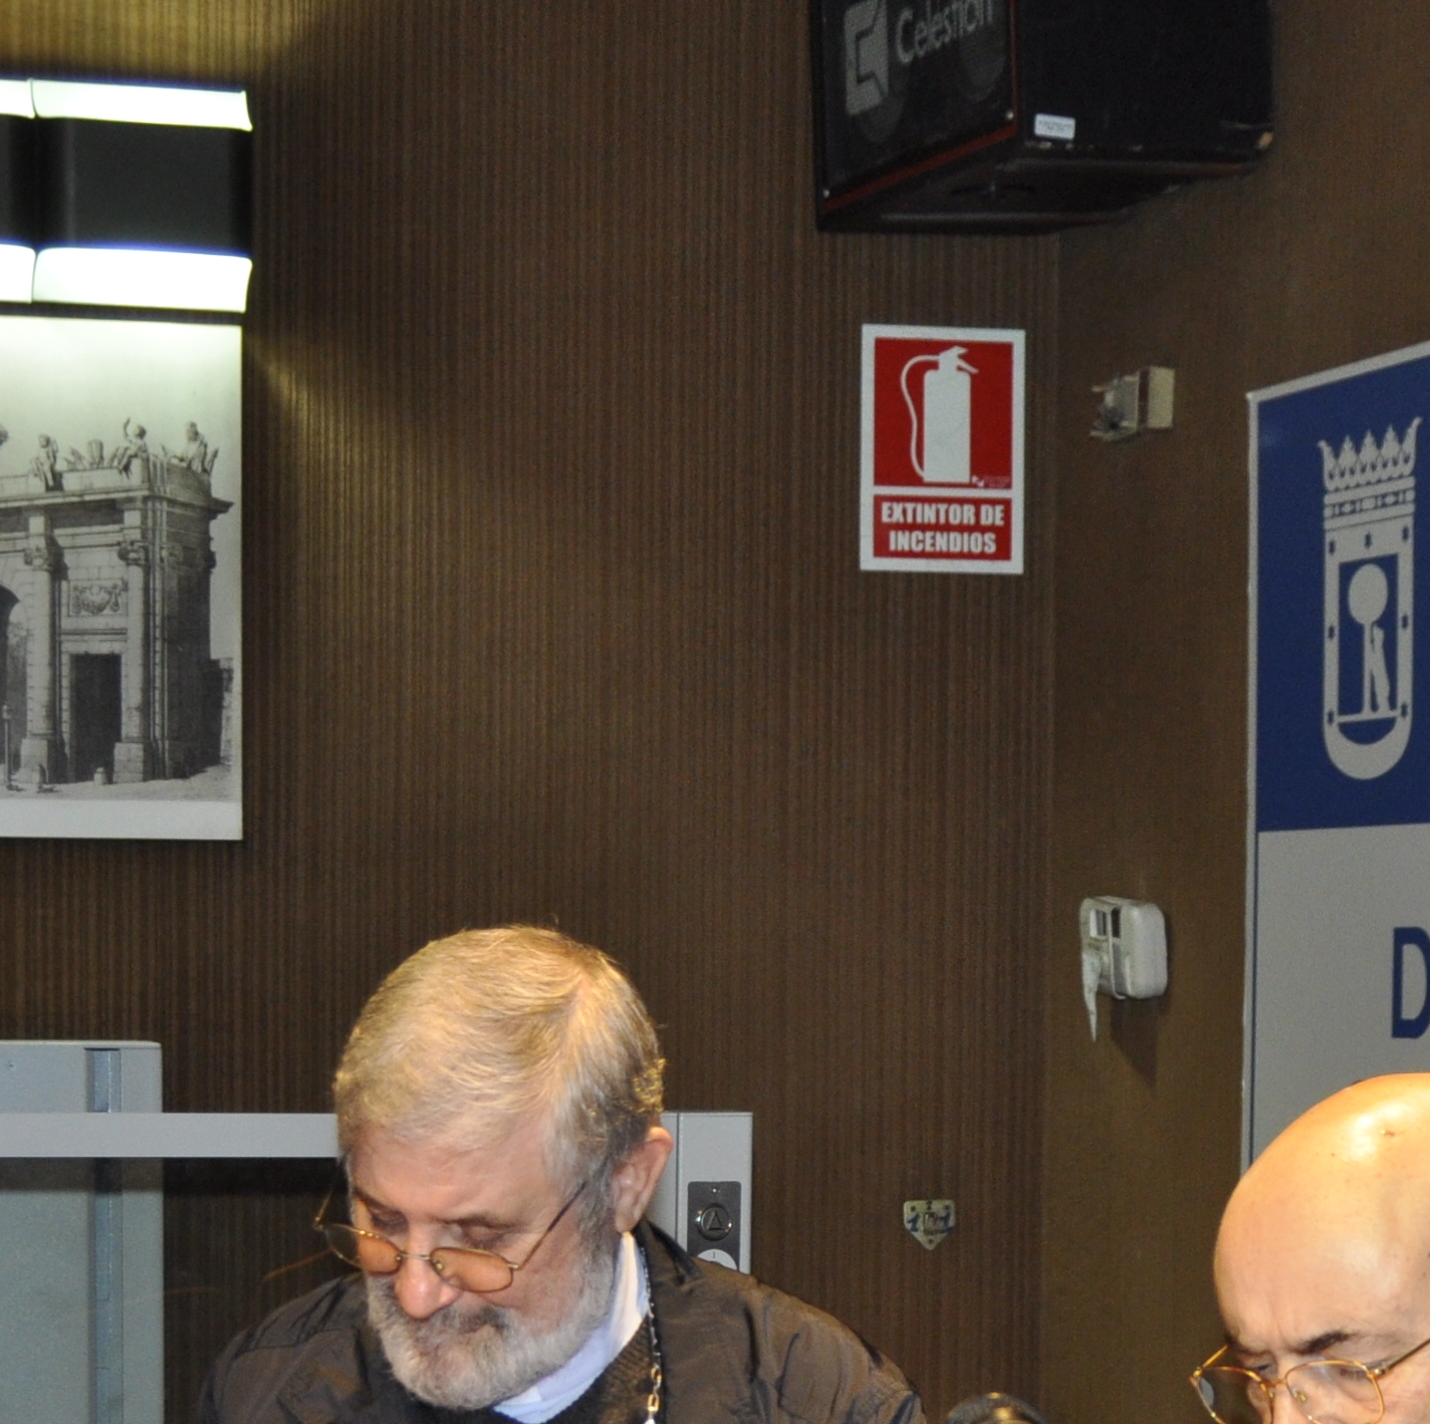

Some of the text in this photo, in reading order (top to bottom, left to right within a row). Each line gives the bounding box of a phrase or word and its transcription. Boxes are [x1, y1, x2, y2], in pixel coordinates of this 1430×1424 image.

[881, 501, 1005, 527] EXTINTOR DE
[889, 530, 997, 554] INCENDIOS
